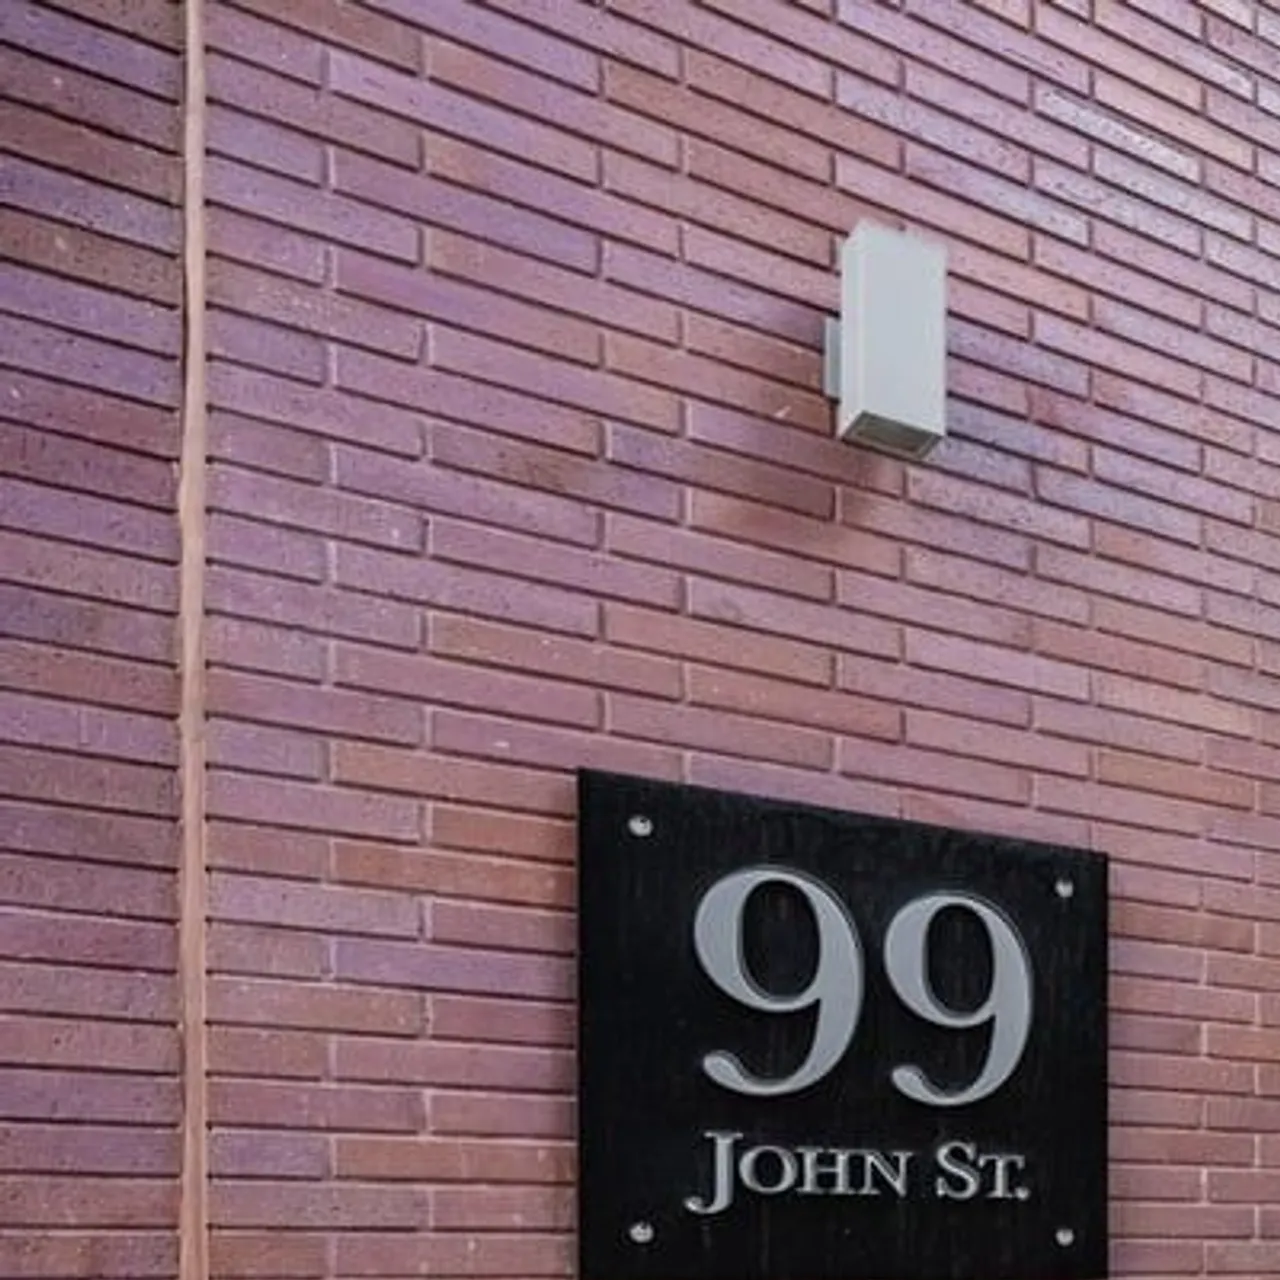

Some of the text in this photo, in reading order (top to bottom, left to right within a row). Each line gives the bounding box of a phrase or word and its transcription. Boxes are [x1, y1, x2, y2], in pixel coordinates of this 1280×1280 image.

[694, 866, 1035, 1107] 99
[685, 1131, 1029, 1215] JOHN ST.
